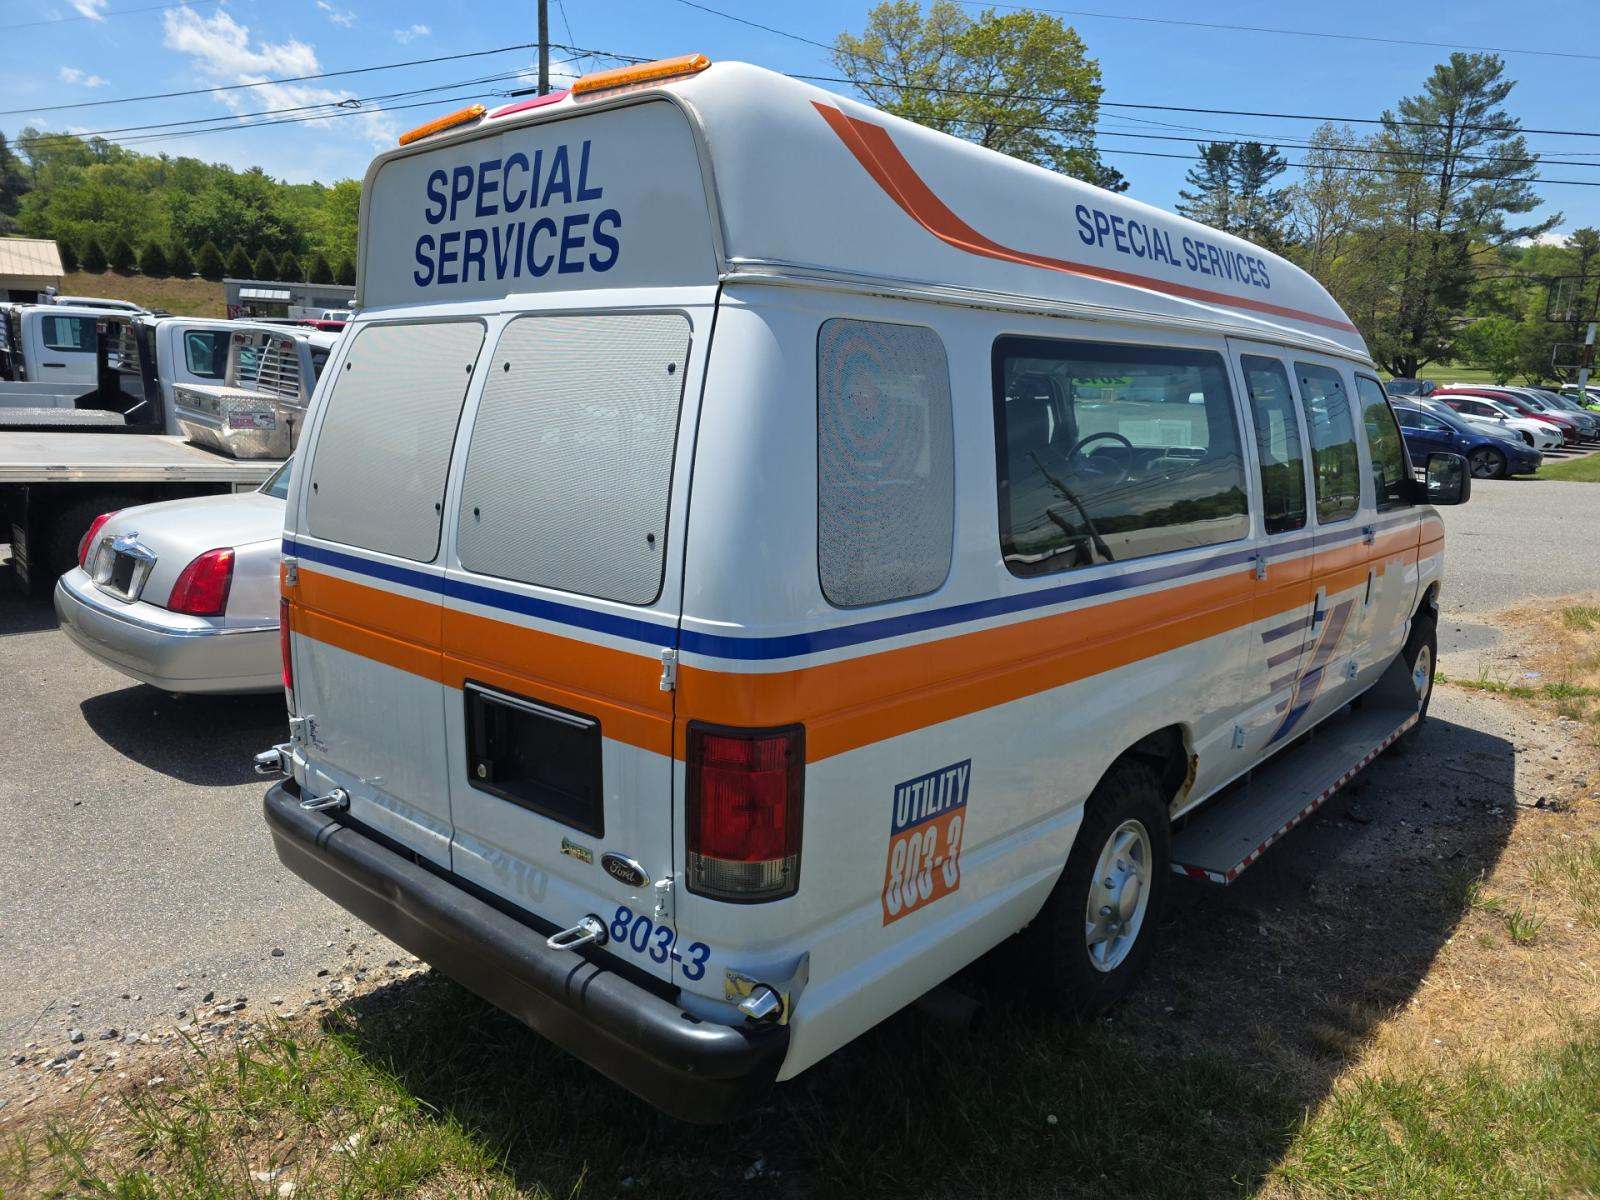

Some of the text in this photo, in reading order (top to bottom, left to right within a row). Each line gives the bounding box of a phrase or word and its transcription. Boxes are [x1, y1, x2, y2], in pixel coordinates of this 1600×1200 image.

[425, 140, 603, 225] SPECIAL
[414, 208, 622, 287] SERVICES
[1075, 204, 1271, 290] SPECIAL SERVICES
[896, 764, 969, 828] UTILITY
[609, 859, 635, 882] Ford
[886, 815, 962, 916] 803-3
[610, 905, 711, 982] 803-3
